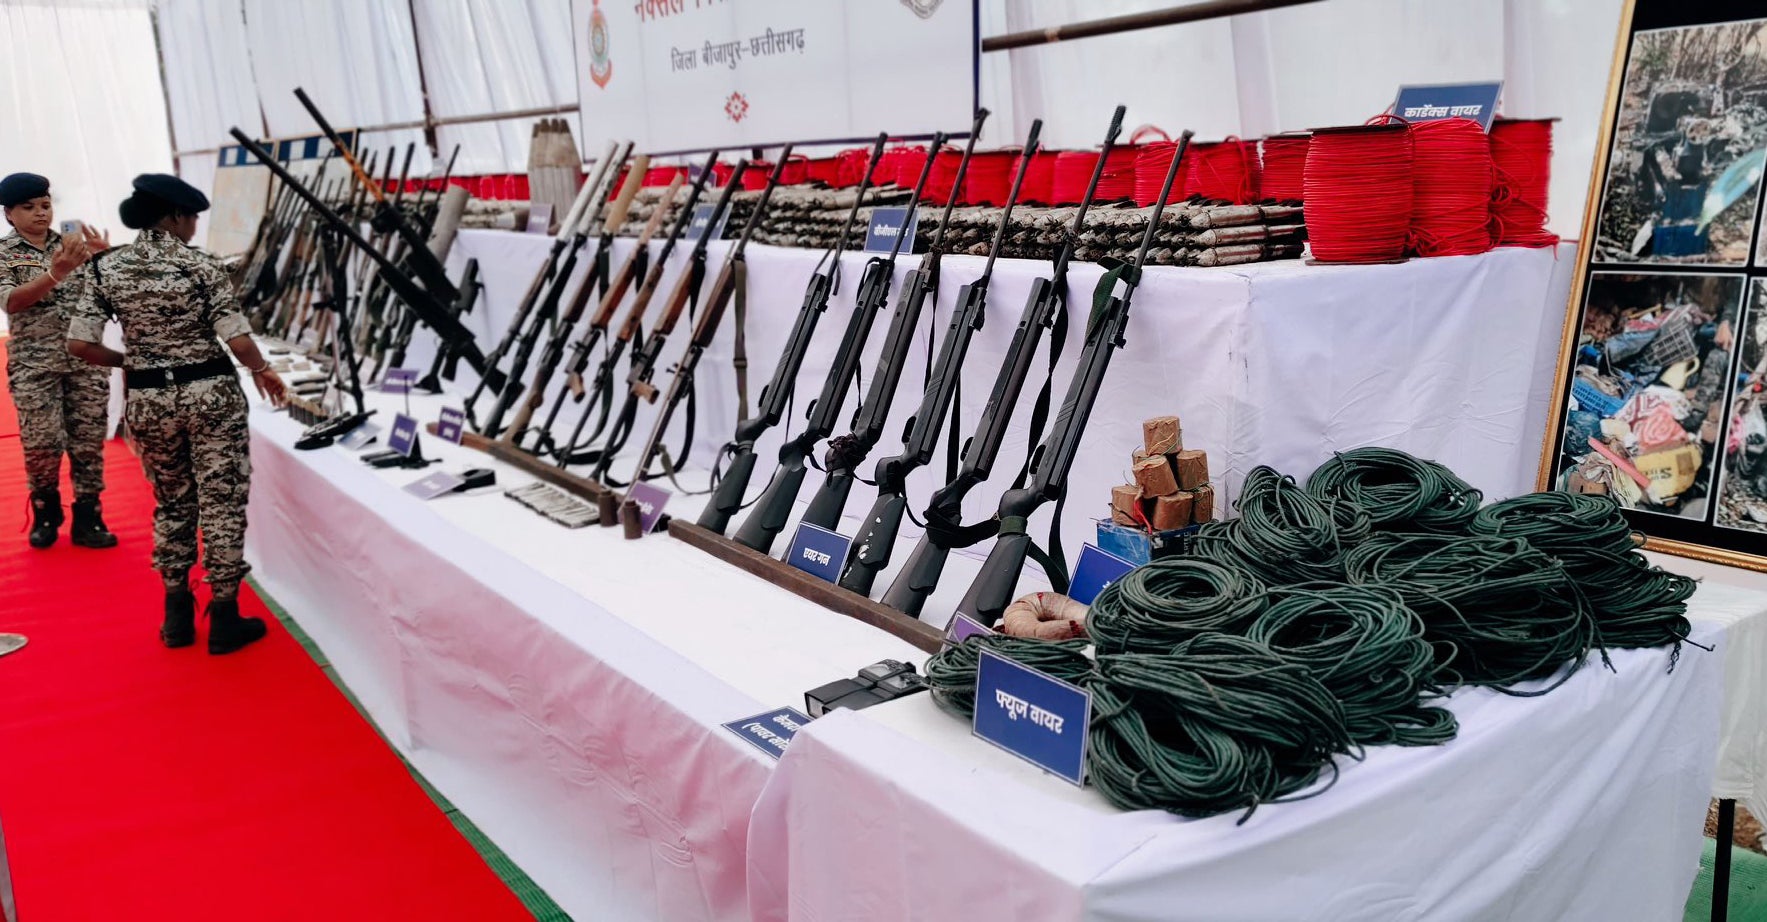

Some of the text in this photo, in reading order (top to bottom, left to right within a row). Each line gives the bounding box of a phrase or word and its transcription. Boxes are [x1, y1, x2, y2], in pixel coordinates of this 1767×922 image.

[670, 47, 697, 73] जिला
[1449, 105, 1483, 116] वायर
[803, 547, 831, 566] एयर गन
[995, 689, 1064, 734] फ्यूज वायर
